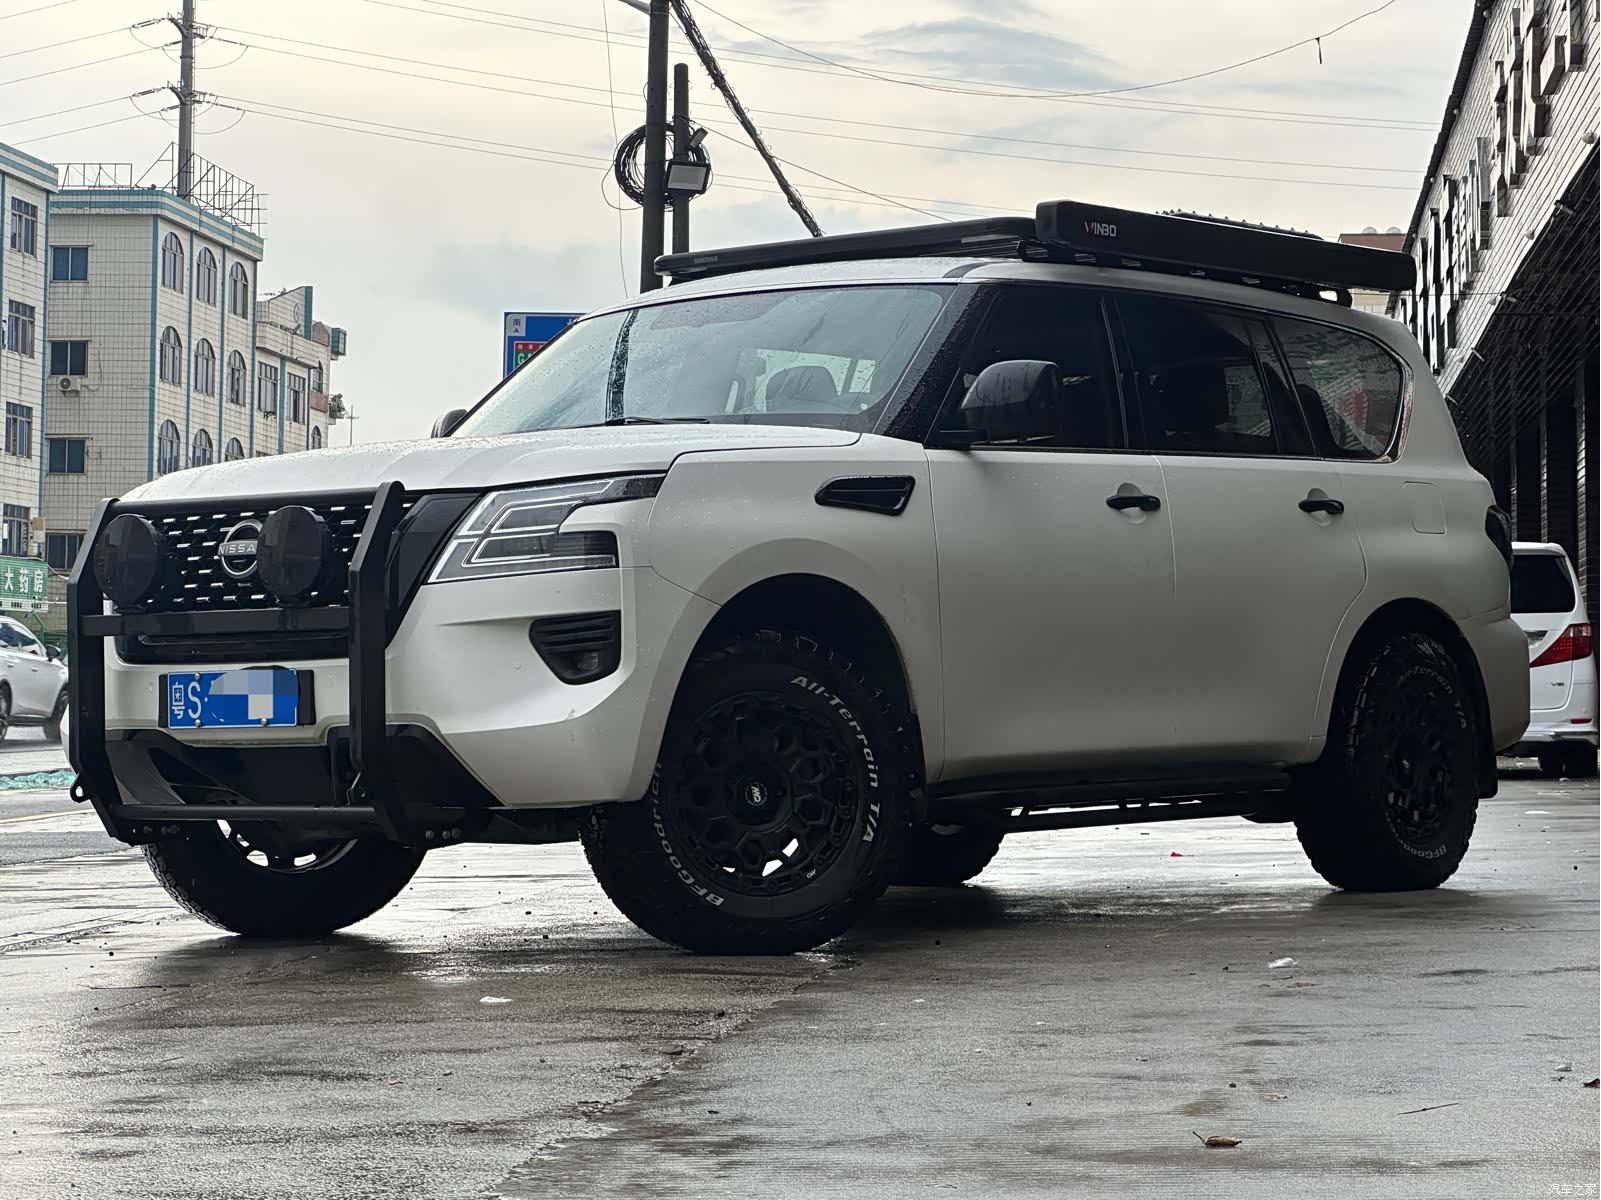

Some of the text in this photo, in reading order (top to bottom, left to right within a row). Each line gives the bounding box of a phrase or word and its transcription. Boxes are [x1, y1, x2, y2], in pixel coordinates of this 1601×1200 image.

[513, 318, 521, 327] 南
[219, 543, 257, 554] NISSA
[4, 566, 44, 593] 大药房
[790, 675, 881, 843] All-Terrain T/A
